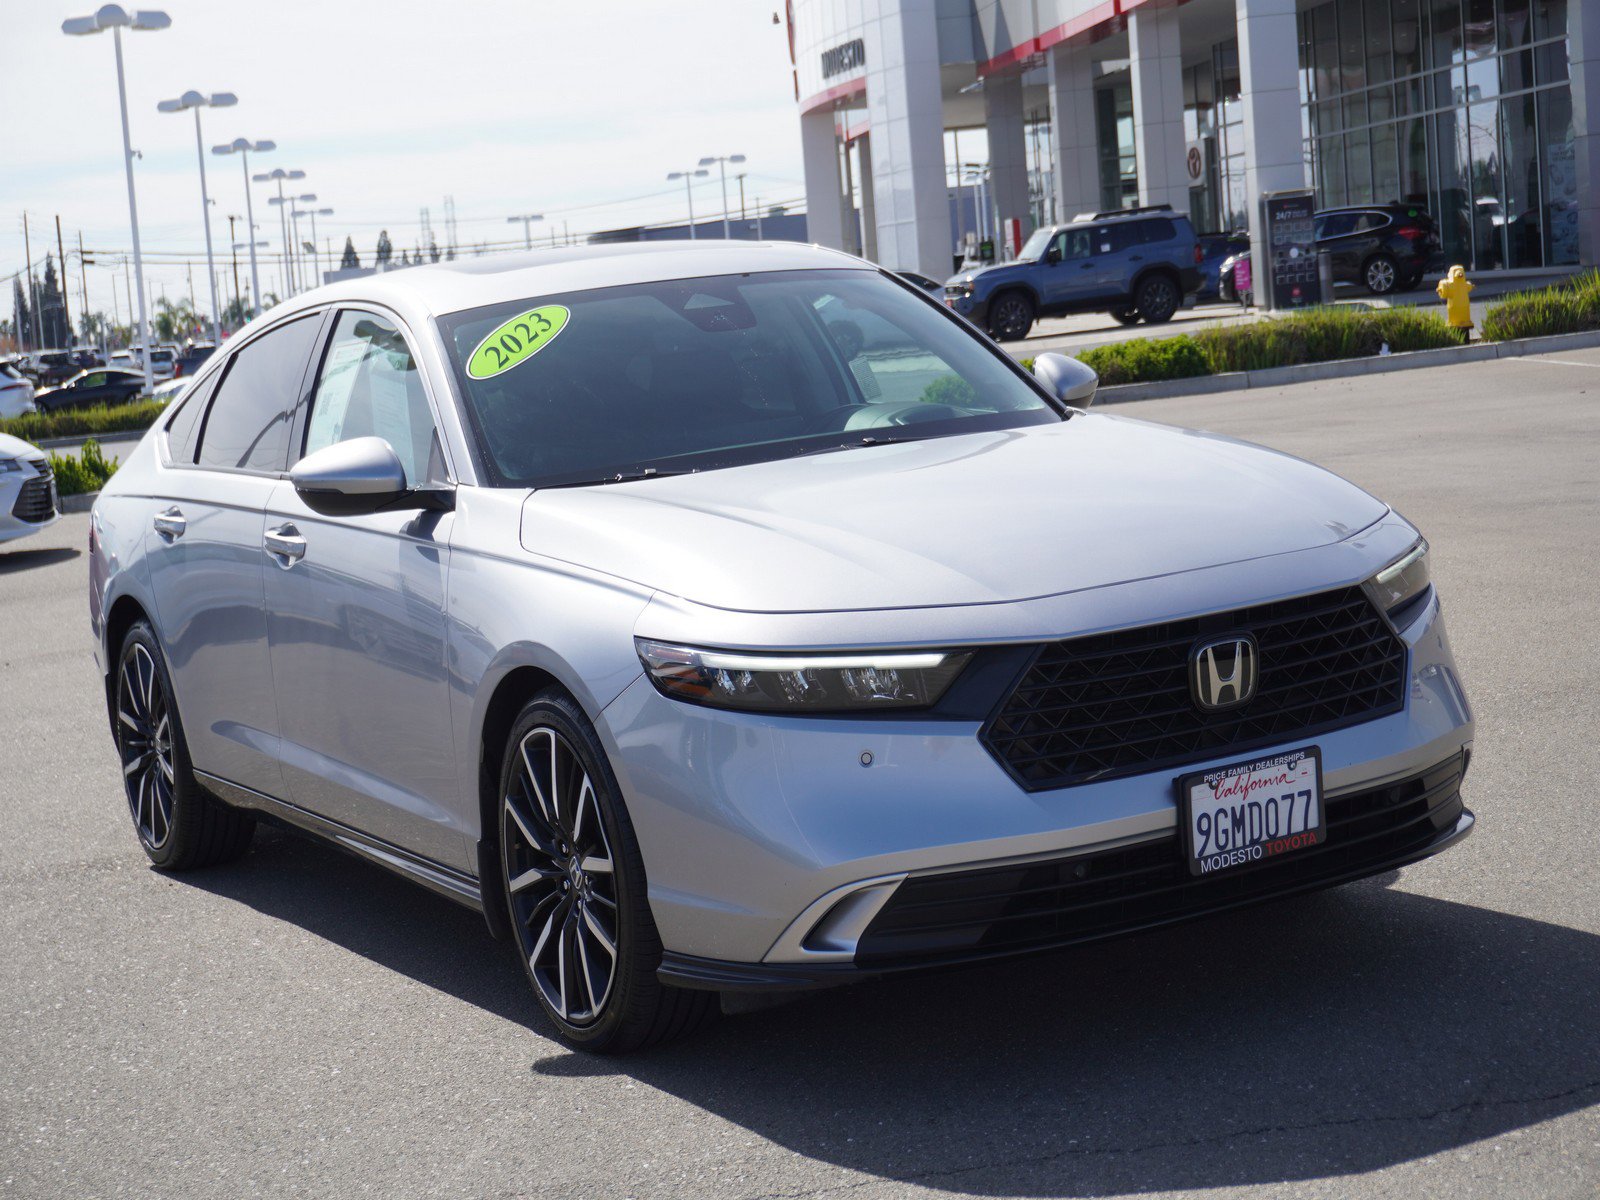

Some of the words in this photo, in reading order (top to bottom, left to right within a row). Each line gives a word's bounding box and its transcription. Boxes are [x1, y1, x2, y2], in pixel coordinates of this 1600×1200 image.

[484, 313, 552, 369] 2023
[1203, 771, 1226, 782] PRICE
[1227, 764, 1254, 777] FAMILY
[1255, 752, 1305, 771] DEALERSHIPS
[1214, 771, 1296, 800] California
[1196, 789, 1312, 857] 9GMD077
[1201, 845, 1262, 873] MODESTO
[1266, 831, 1317, 856] TOYOTA
